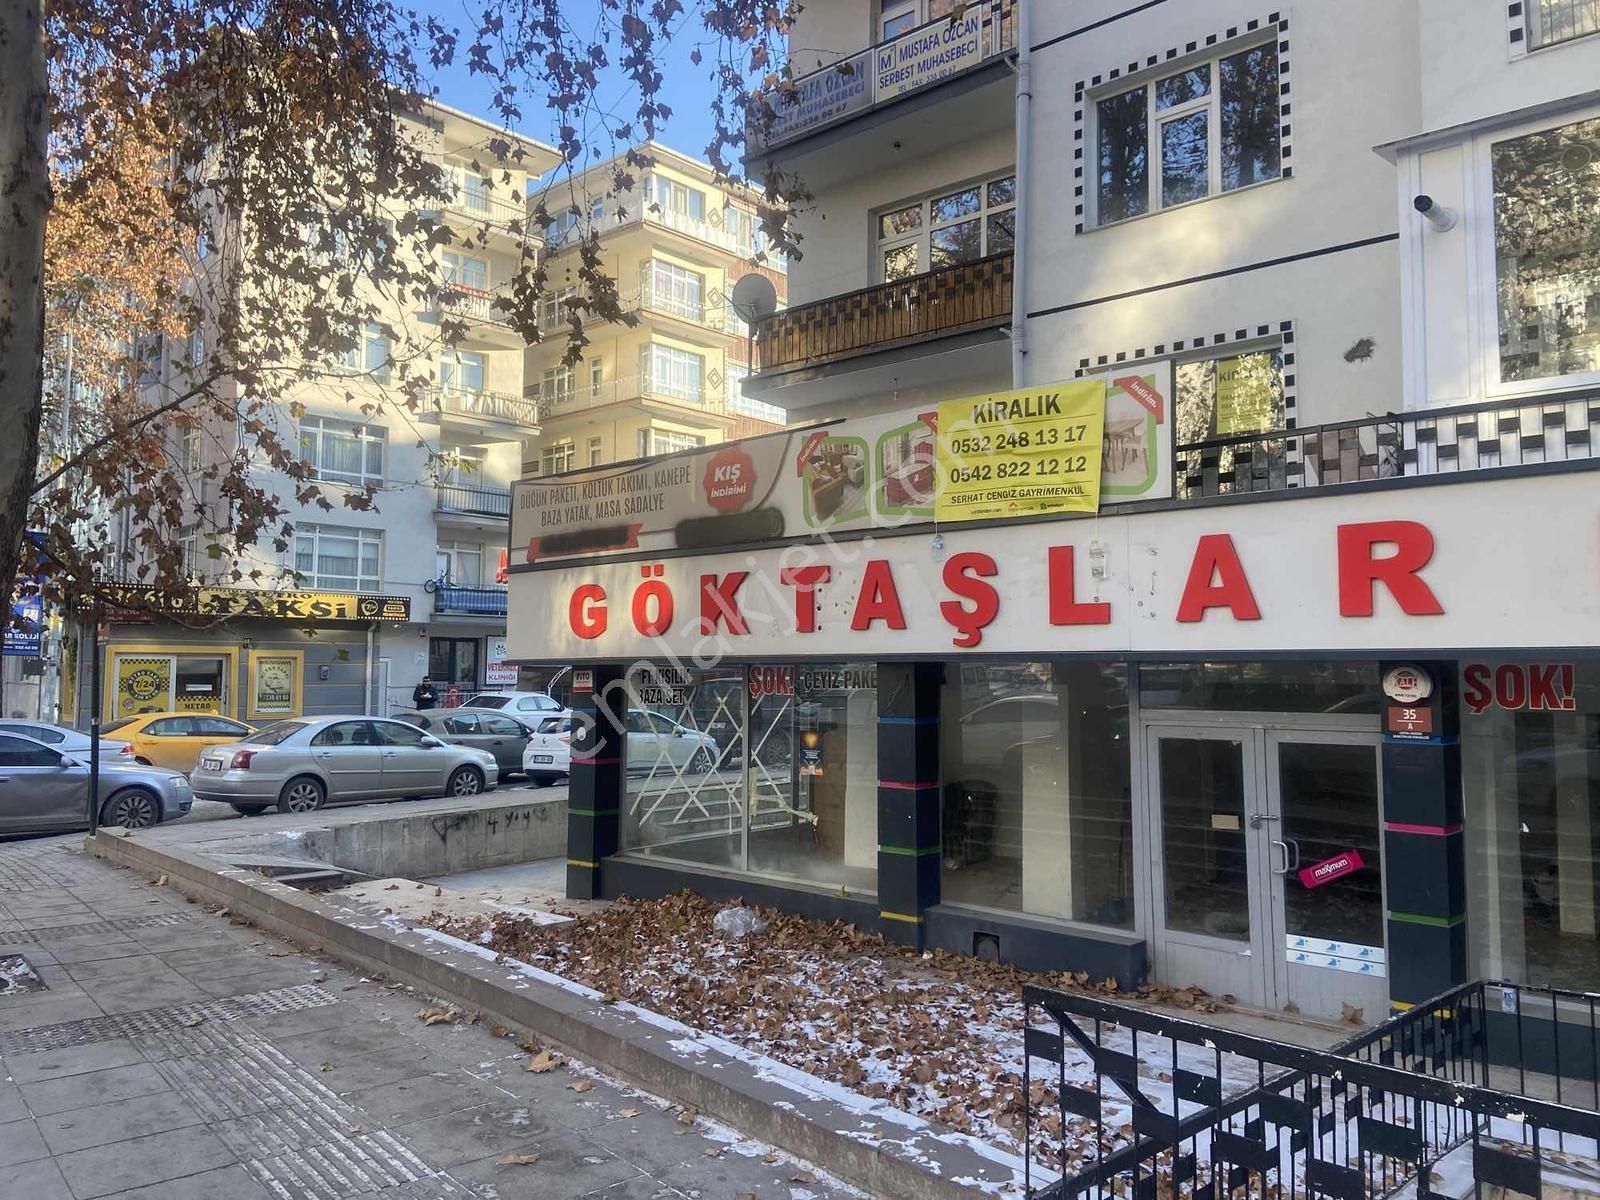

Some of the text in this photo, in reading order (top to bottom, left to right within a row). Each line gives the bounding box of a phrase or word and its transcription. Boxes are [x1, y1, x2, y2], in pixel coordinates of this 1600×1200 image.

[899, 32, 941, 63] MUSTAFA
[879, 65, 915, 89] SERBEST
[973, 393, 1062, 424] KİRALIK
[951, 424, 1087, 455] 0532 248 13 17
[714, 463, 741, 484] KIŞ
[950, 456, 1087, 484] 0542 822 12 12
[520, 487, 548, 510] DÜĞÜN
[582, 478, 613, 500] KOLTUK
[654, 465, 692, 489] KANEPE
[951, 493, 984, 505] SERHAT
[1018, 484, 1085, 498] GAYRİMENKUL
[541, 492, 665, 528] BAZA YATAK, MASA SADALYE
[134, 678, 155, 689] 7/24
[665, 687, 684, 704] SET
[750, 666, 795, 700] ŞOK!
[1463, 663, 1576, 715] ŞOK!
[1403, 708, 1417, 720] 35
[1407, 722, 1414, 730] A
[1315, 859, 1348, 878] maximum
